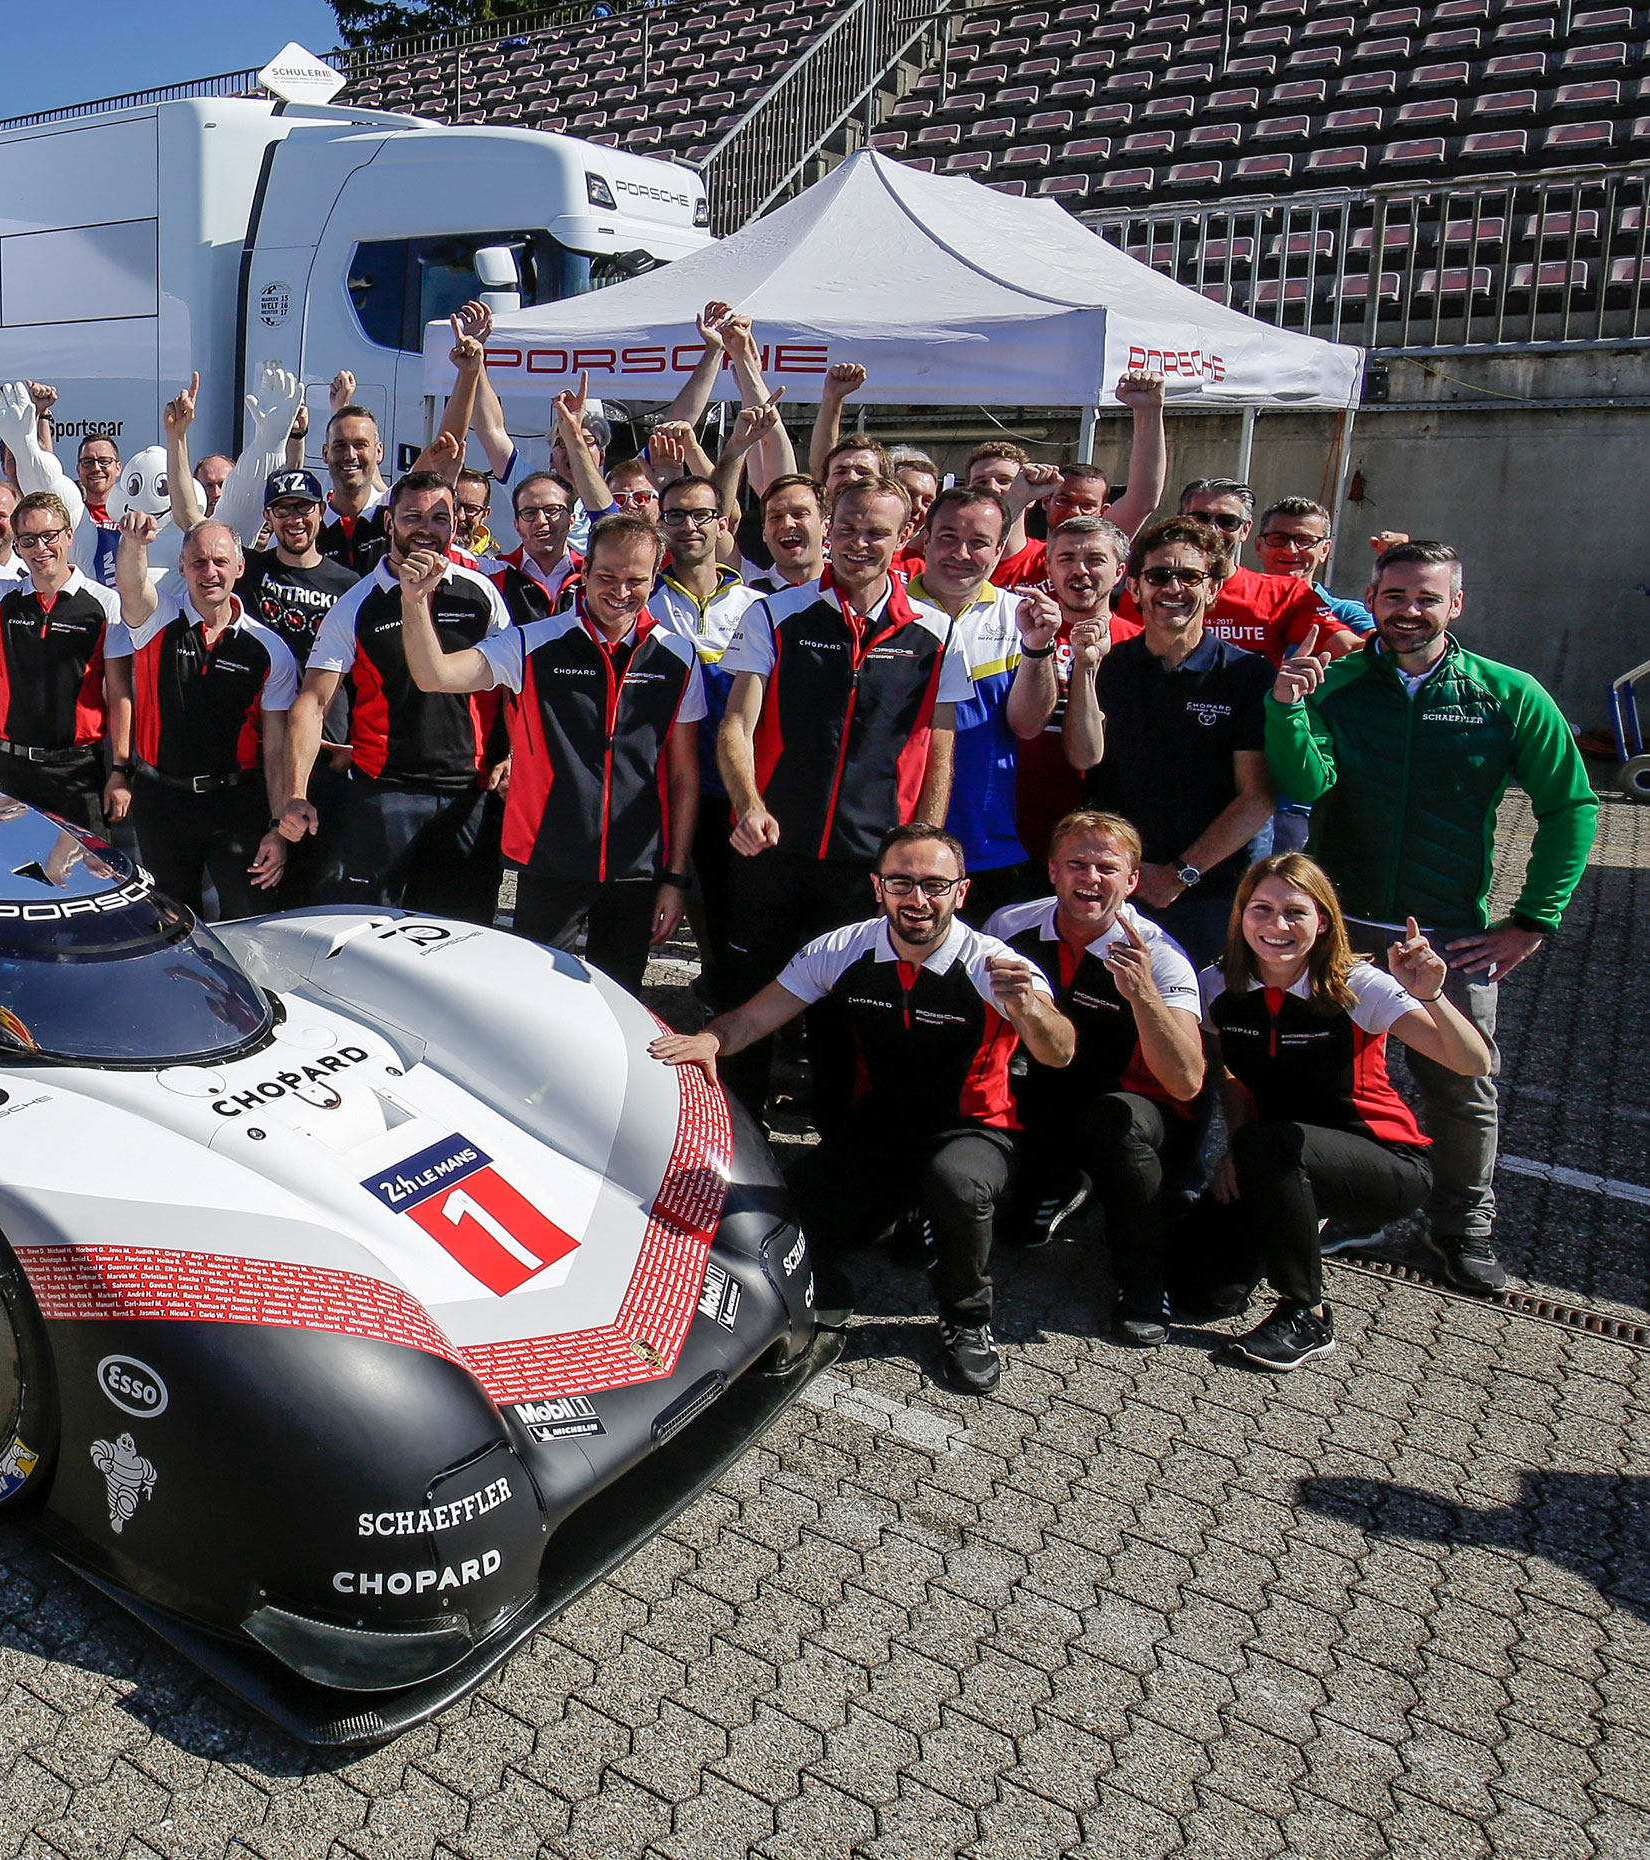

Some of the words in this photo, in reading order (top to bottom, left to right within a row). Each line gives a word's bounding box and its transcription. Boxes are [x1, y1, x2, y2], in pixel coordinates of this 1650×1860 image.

[272, 68, 322, 77] SCHULER
[616, 180, 690, 207] PORSCHE
[1128, 346, 1226, 382] PORSCHE
[50, 419, 124, 442] Sportscar
[272, 473, 306, 493] YZ
[799, 640, 841, 650] CHOPARD
[553, 667, 596, 676] CHOPARD
[1186, 702, 1231, 710] CHOPARD
[1422, 714, 1483, 724] SCHAEFFLER
[849, 997, 892, 1008] CHOPARD
[1074, 991, 1120, 1010] PORSCHE
[916, 1009, 965, 1022] PORSCHE
[212, 1047, 368, 1116] CHOPARD
[379, 1174, 419, 1203] 24h
[415, 1169, 438, 1187] LE
[434, 1147, 478, 1178] MANS
[441, 1188, 545, 1271] 1
[783, 1227, 806, 1277] SCHAE
[698, 1280, 724, 1320] Mobil
[262, 1316, 292, 1324] Alexander
[514, 1398, 576, 1424] Mobil
[552, 1424, 598, 1436] MICHELIN
[358, 1477, 512, 1536] SCHAEFFLER
[332, 1549, 502, 1595] CHOPARD
